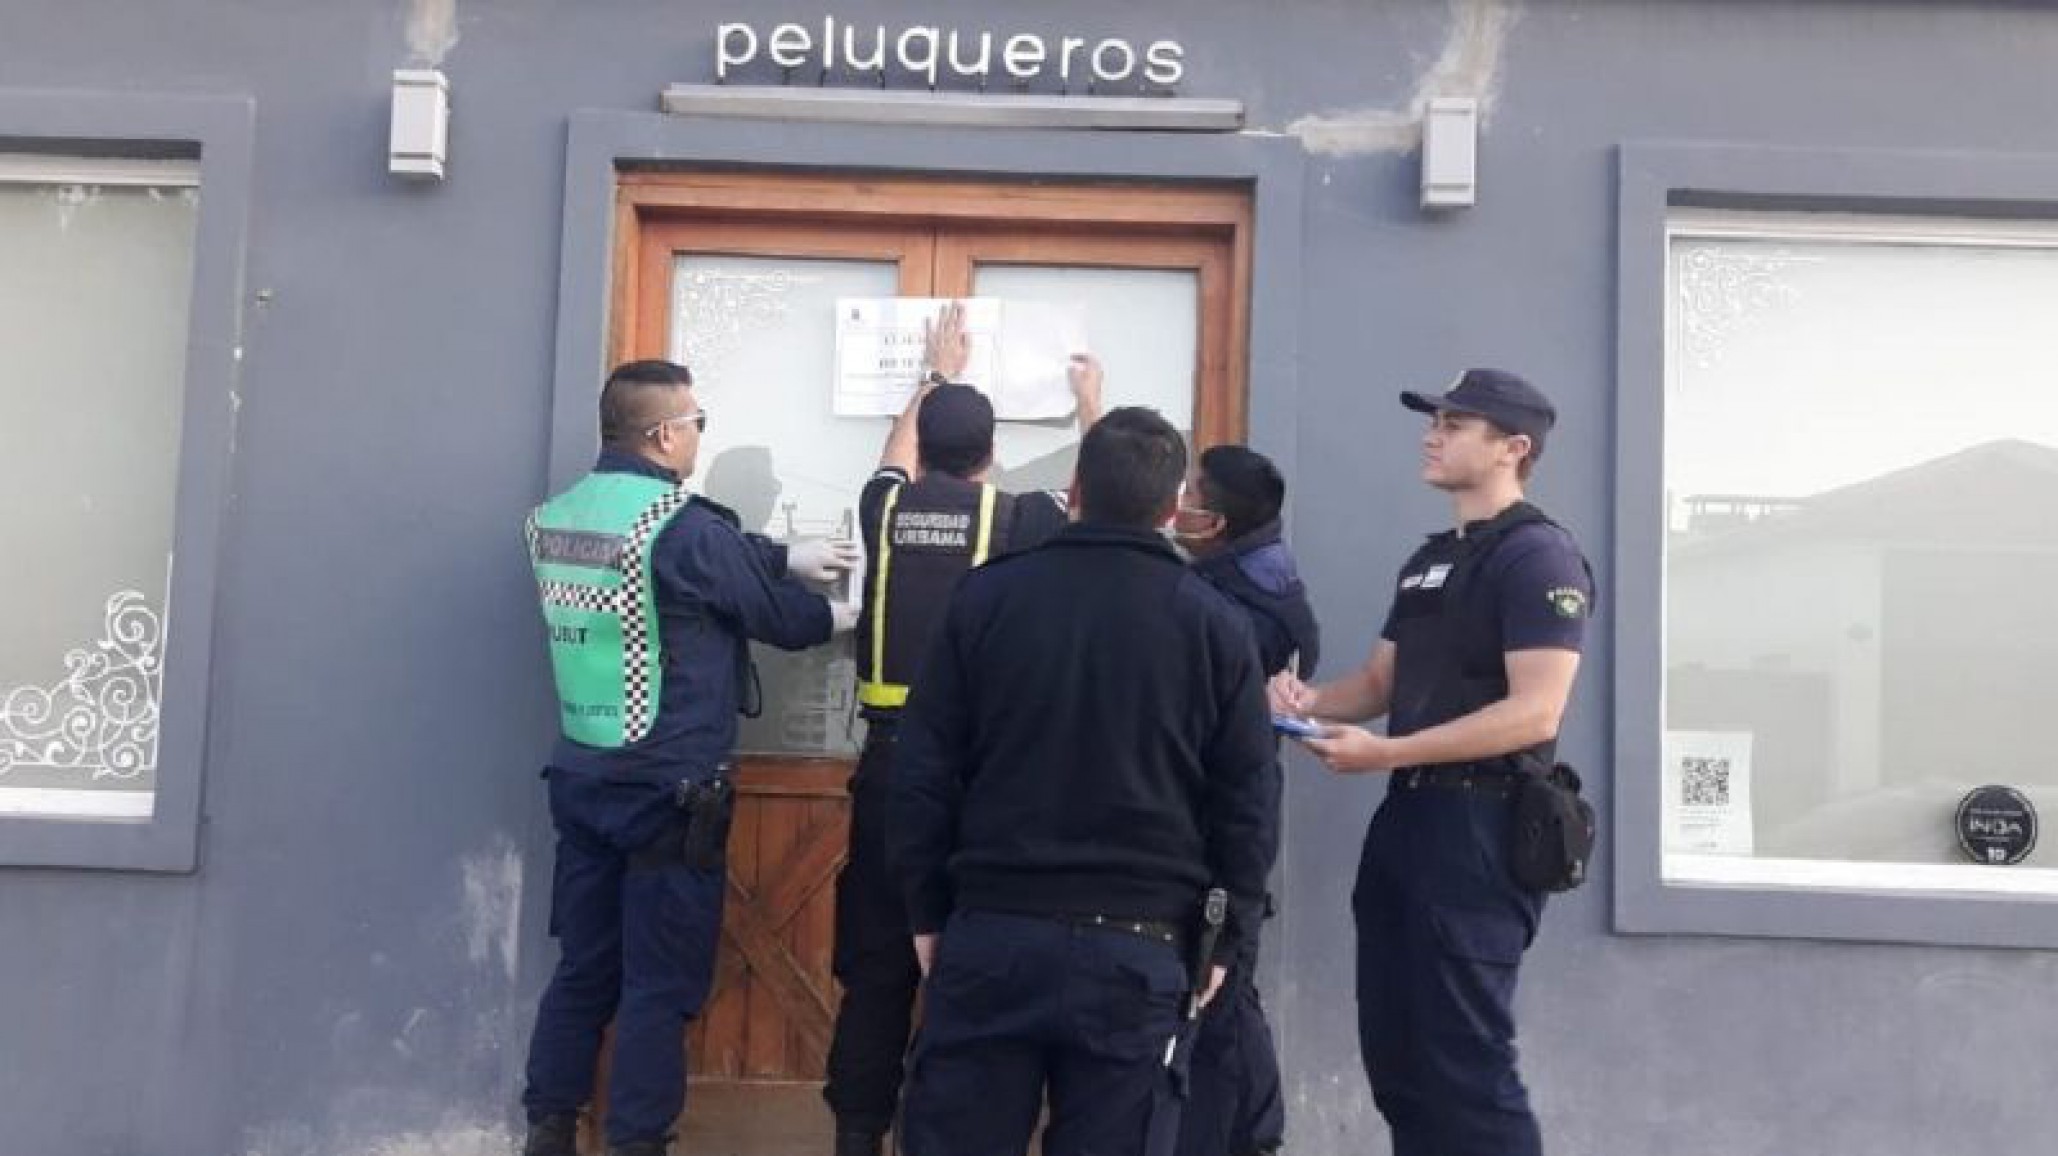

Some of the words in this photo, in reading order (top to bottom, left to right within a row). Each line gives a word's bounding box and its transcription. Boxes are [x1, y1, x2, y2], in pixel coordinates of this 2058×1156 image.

[715, 15, 1185, 84] peluqueros
[896, 511, 971, 529] SEGURIDAD
[894, 529, 967, 546] URBANA
